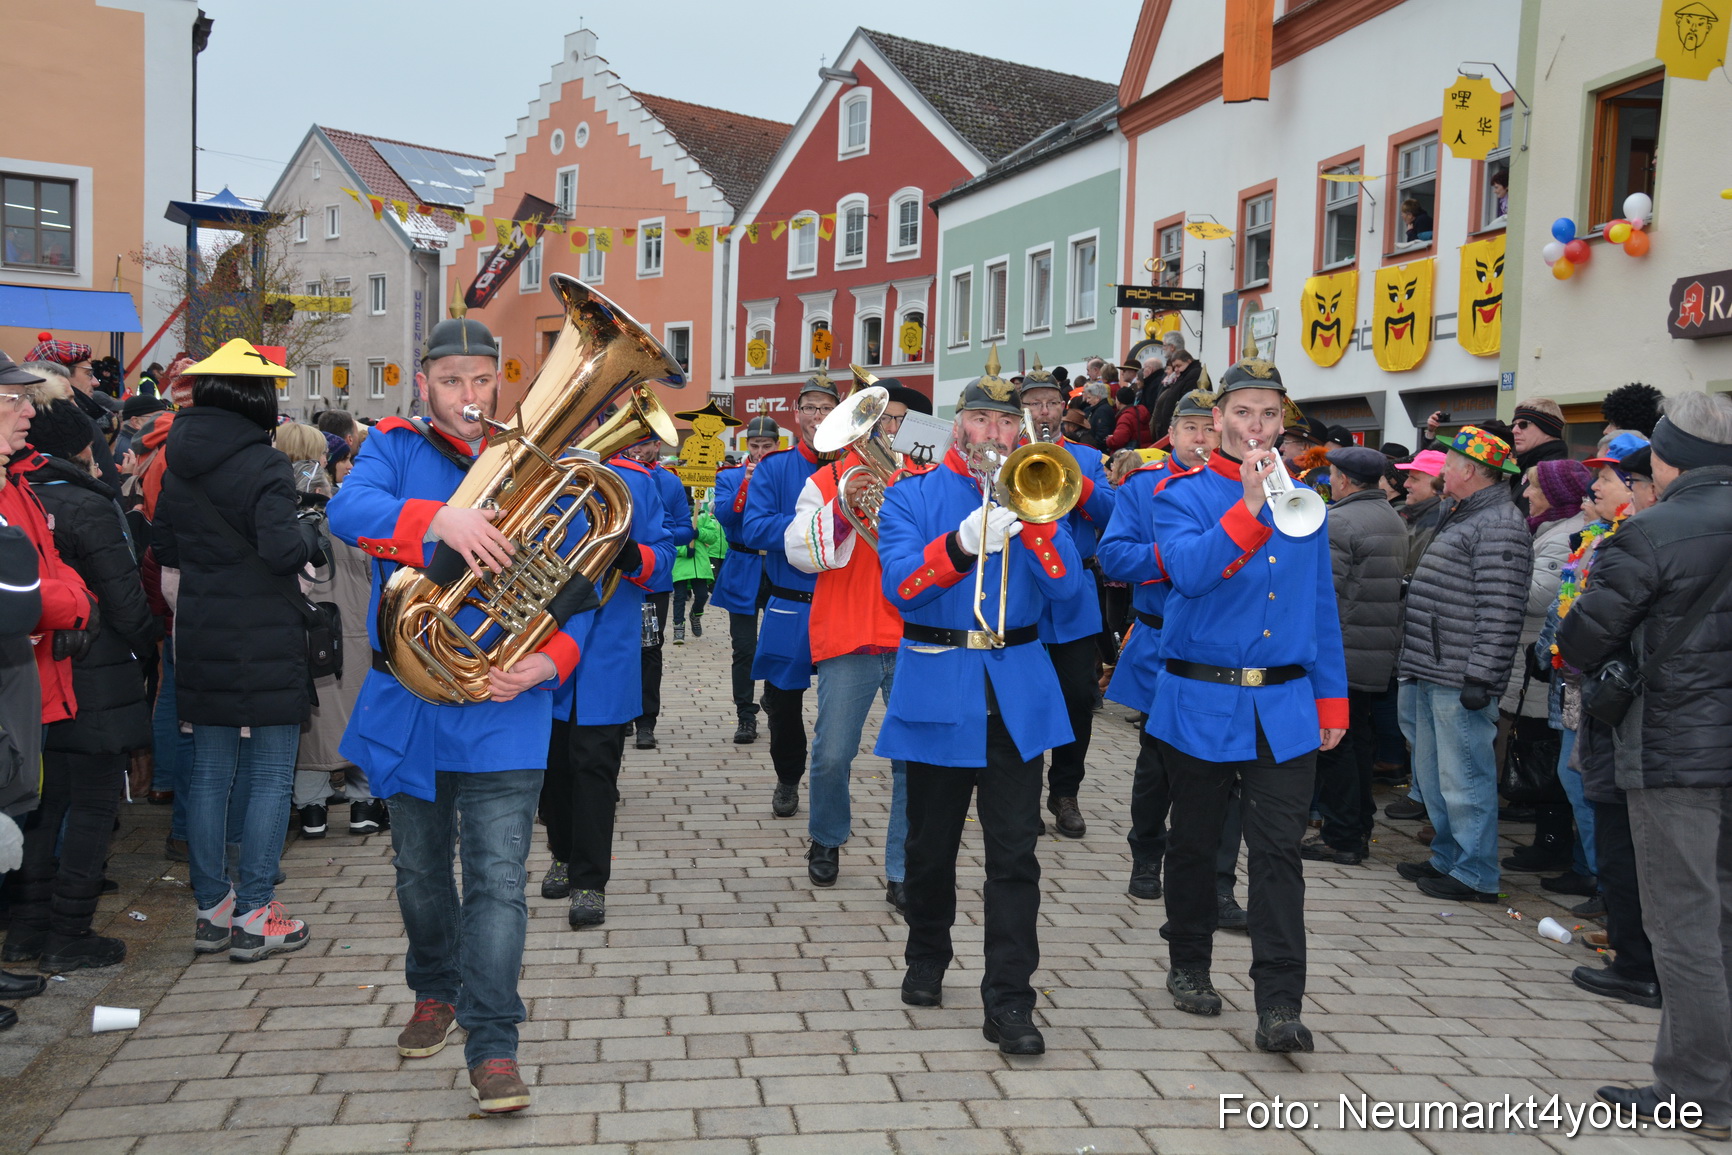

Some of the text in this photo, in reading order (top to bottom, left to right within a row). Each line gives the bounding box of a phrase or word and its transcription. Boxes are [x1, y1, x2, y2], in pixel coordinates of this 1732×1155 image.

[1126, 289, 1195, 302] RÖHLICH
[413, 291, 422, 341] UHREN
[1503, 373, 1513, 384] 20
[711, 396, 731, 407] CAFÉ
[1451, 397, 1495, 412] UHREN
[694, 489, 705, 499] 39
